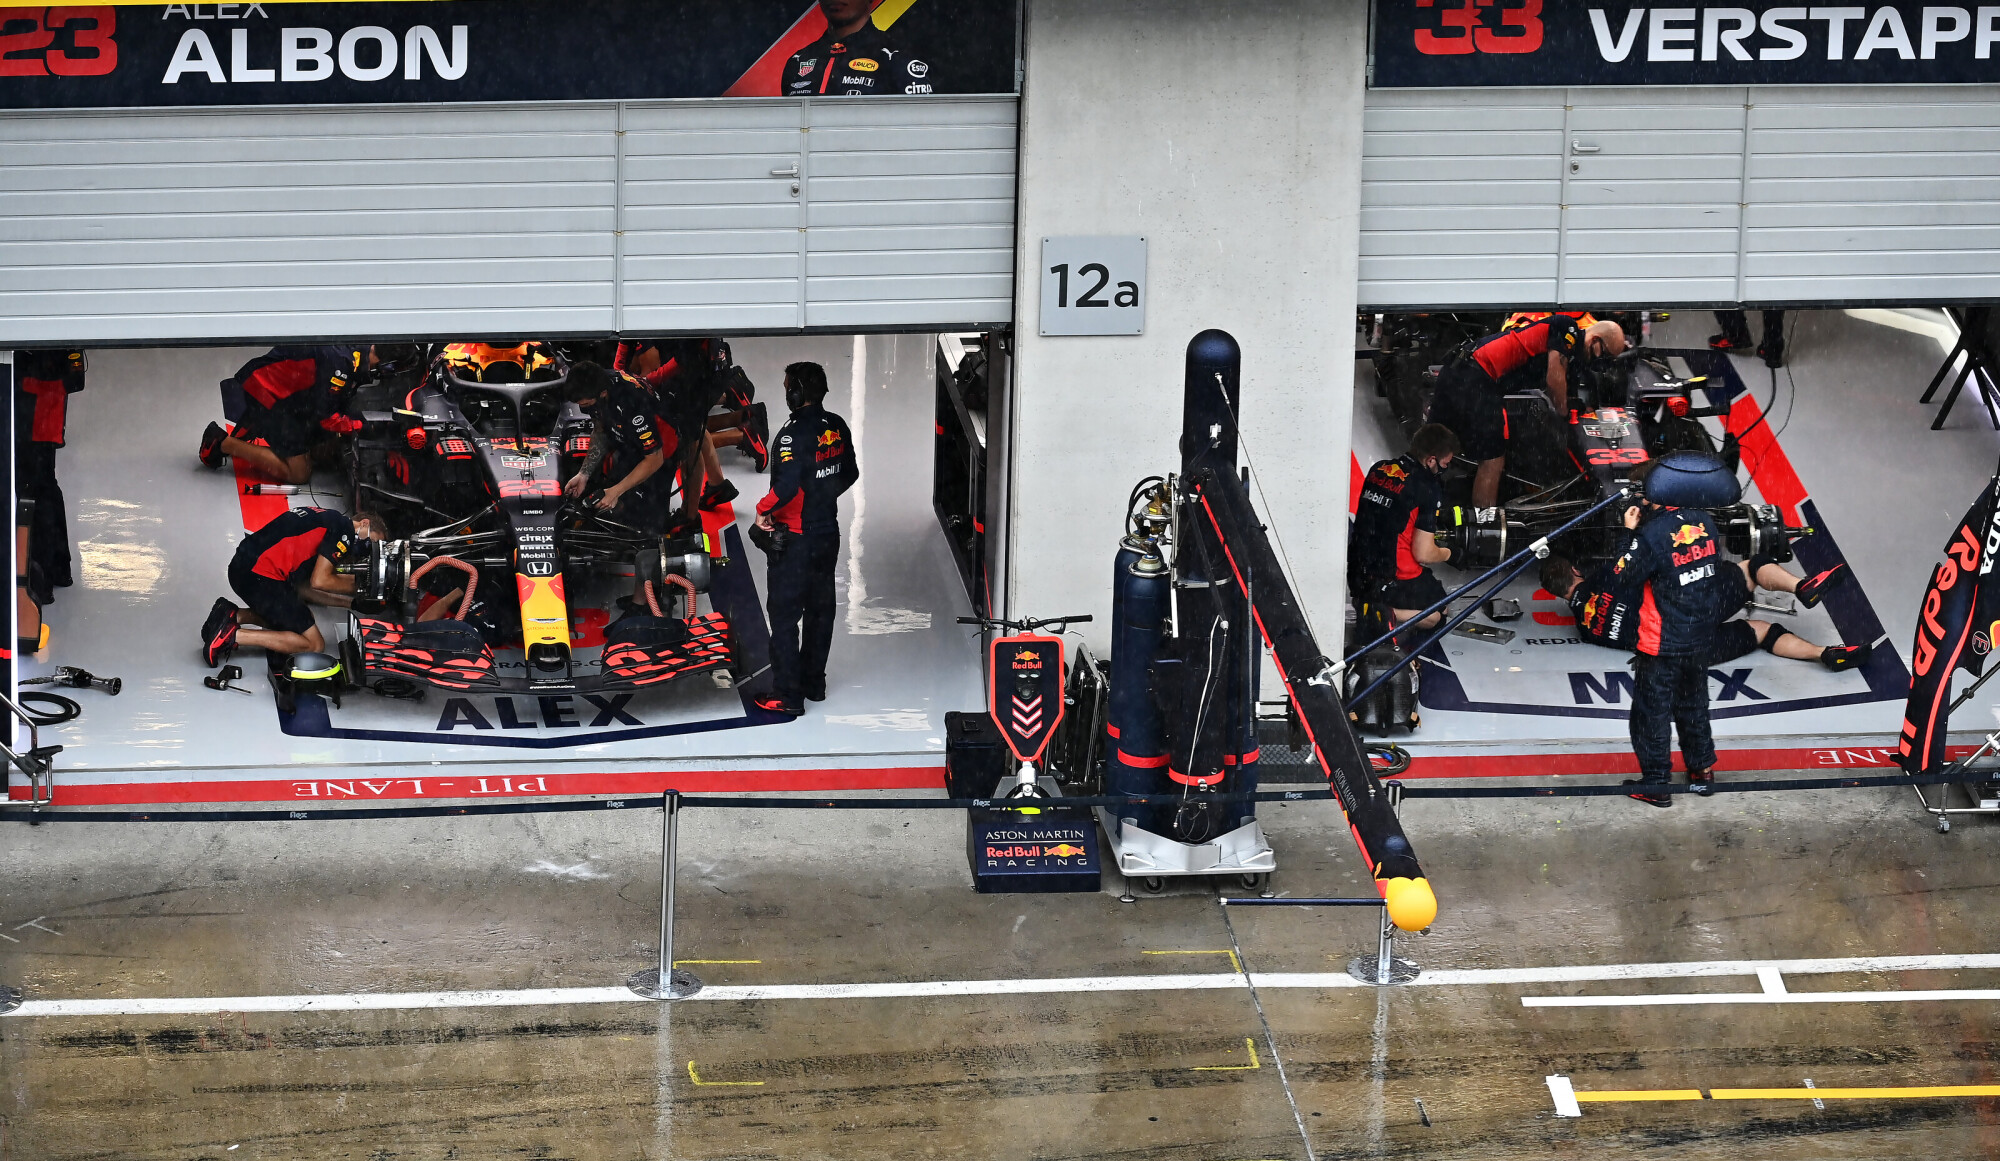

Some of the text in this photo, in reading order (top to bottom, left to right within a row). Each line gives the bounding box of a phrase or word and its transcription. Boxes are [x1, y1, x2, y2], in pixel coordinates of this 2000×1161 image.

[162, 3, 269, 20] ALEX
[1414, 0, 1544, 55] 33
[0, 5, 118, 76] 23
[162, 25, 468, 84] ALBON
[911, 63, 925, 72] Esso
[842, 76, 865, 85] Mobil
[1050, 262, 1139, 308] 12a
[816, 443, 845, 462] Red Bull
[1586, 448, 1650, 465] 33
[816, 465, 834, 478] Mobil
[498, 480, 562, 498] 23
[1385, 479, 1405, 494] Bull
[1363, 489, 1384, 505] Mobil
[1671, 539, 1716, 567] Red Bull
[1679, 566, 1705, 586] Mobil
[1592, 592, 1614, 637] Red Bull
[1608, 613, 1623, 641] Mobil
[1012, 660, 1042, 670] Red Bull
[1567, 668, 1771, 704] MX
[436, 694, 646, 731] ALEX
[292, 779, 424, 797] LANE
[470, 777, 548, 794] PIT
[985, 830, 1084, 840] ASTON MARTIN
[986, 845, 1040, 858] Red Bull
[988, 858, 1087, 867] RACING
